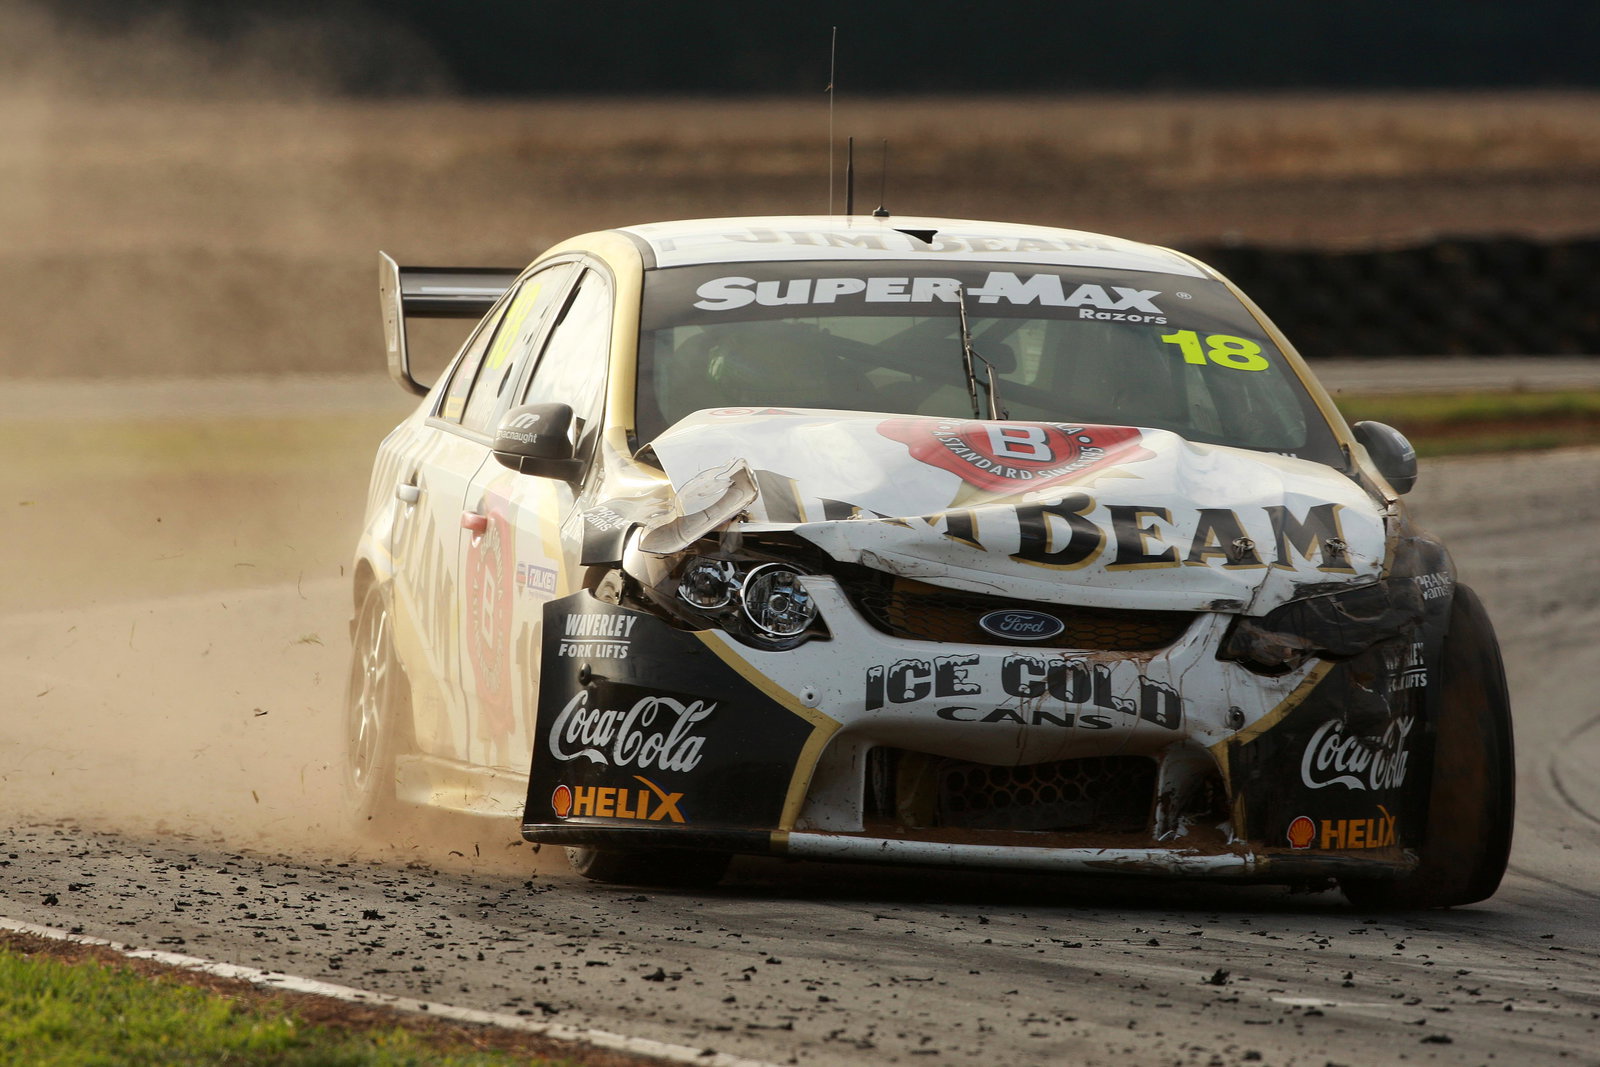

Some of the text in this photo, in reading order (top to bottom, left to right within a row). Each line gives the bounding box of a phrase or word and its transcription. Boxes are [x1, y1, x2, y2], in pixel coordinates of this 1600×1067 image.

[721, 227, 890, 251] JIM
[1078, 308, 1168, 325] Razors
[1161, 329, 1269, 371] 18
[938, 437, 1034, 480] STANDARD
[981, 423, 1054, 463] B
[1007, 491, 1358, 576] BEAM
[564, 613, 638, 638] WAVERLEY
[1000, 614, 1046, 632] Ford
[558, 643, 629, 659] FORK LIFTS
[865, 653, 1182, 731] ICE COLD
[548, 690, 718, 773] Coca-Cola
[936, 706, 1113, 730] CANS
[573, 775, 686, 824] HELIX
[1320, 804, 1396, 850] HELIX
